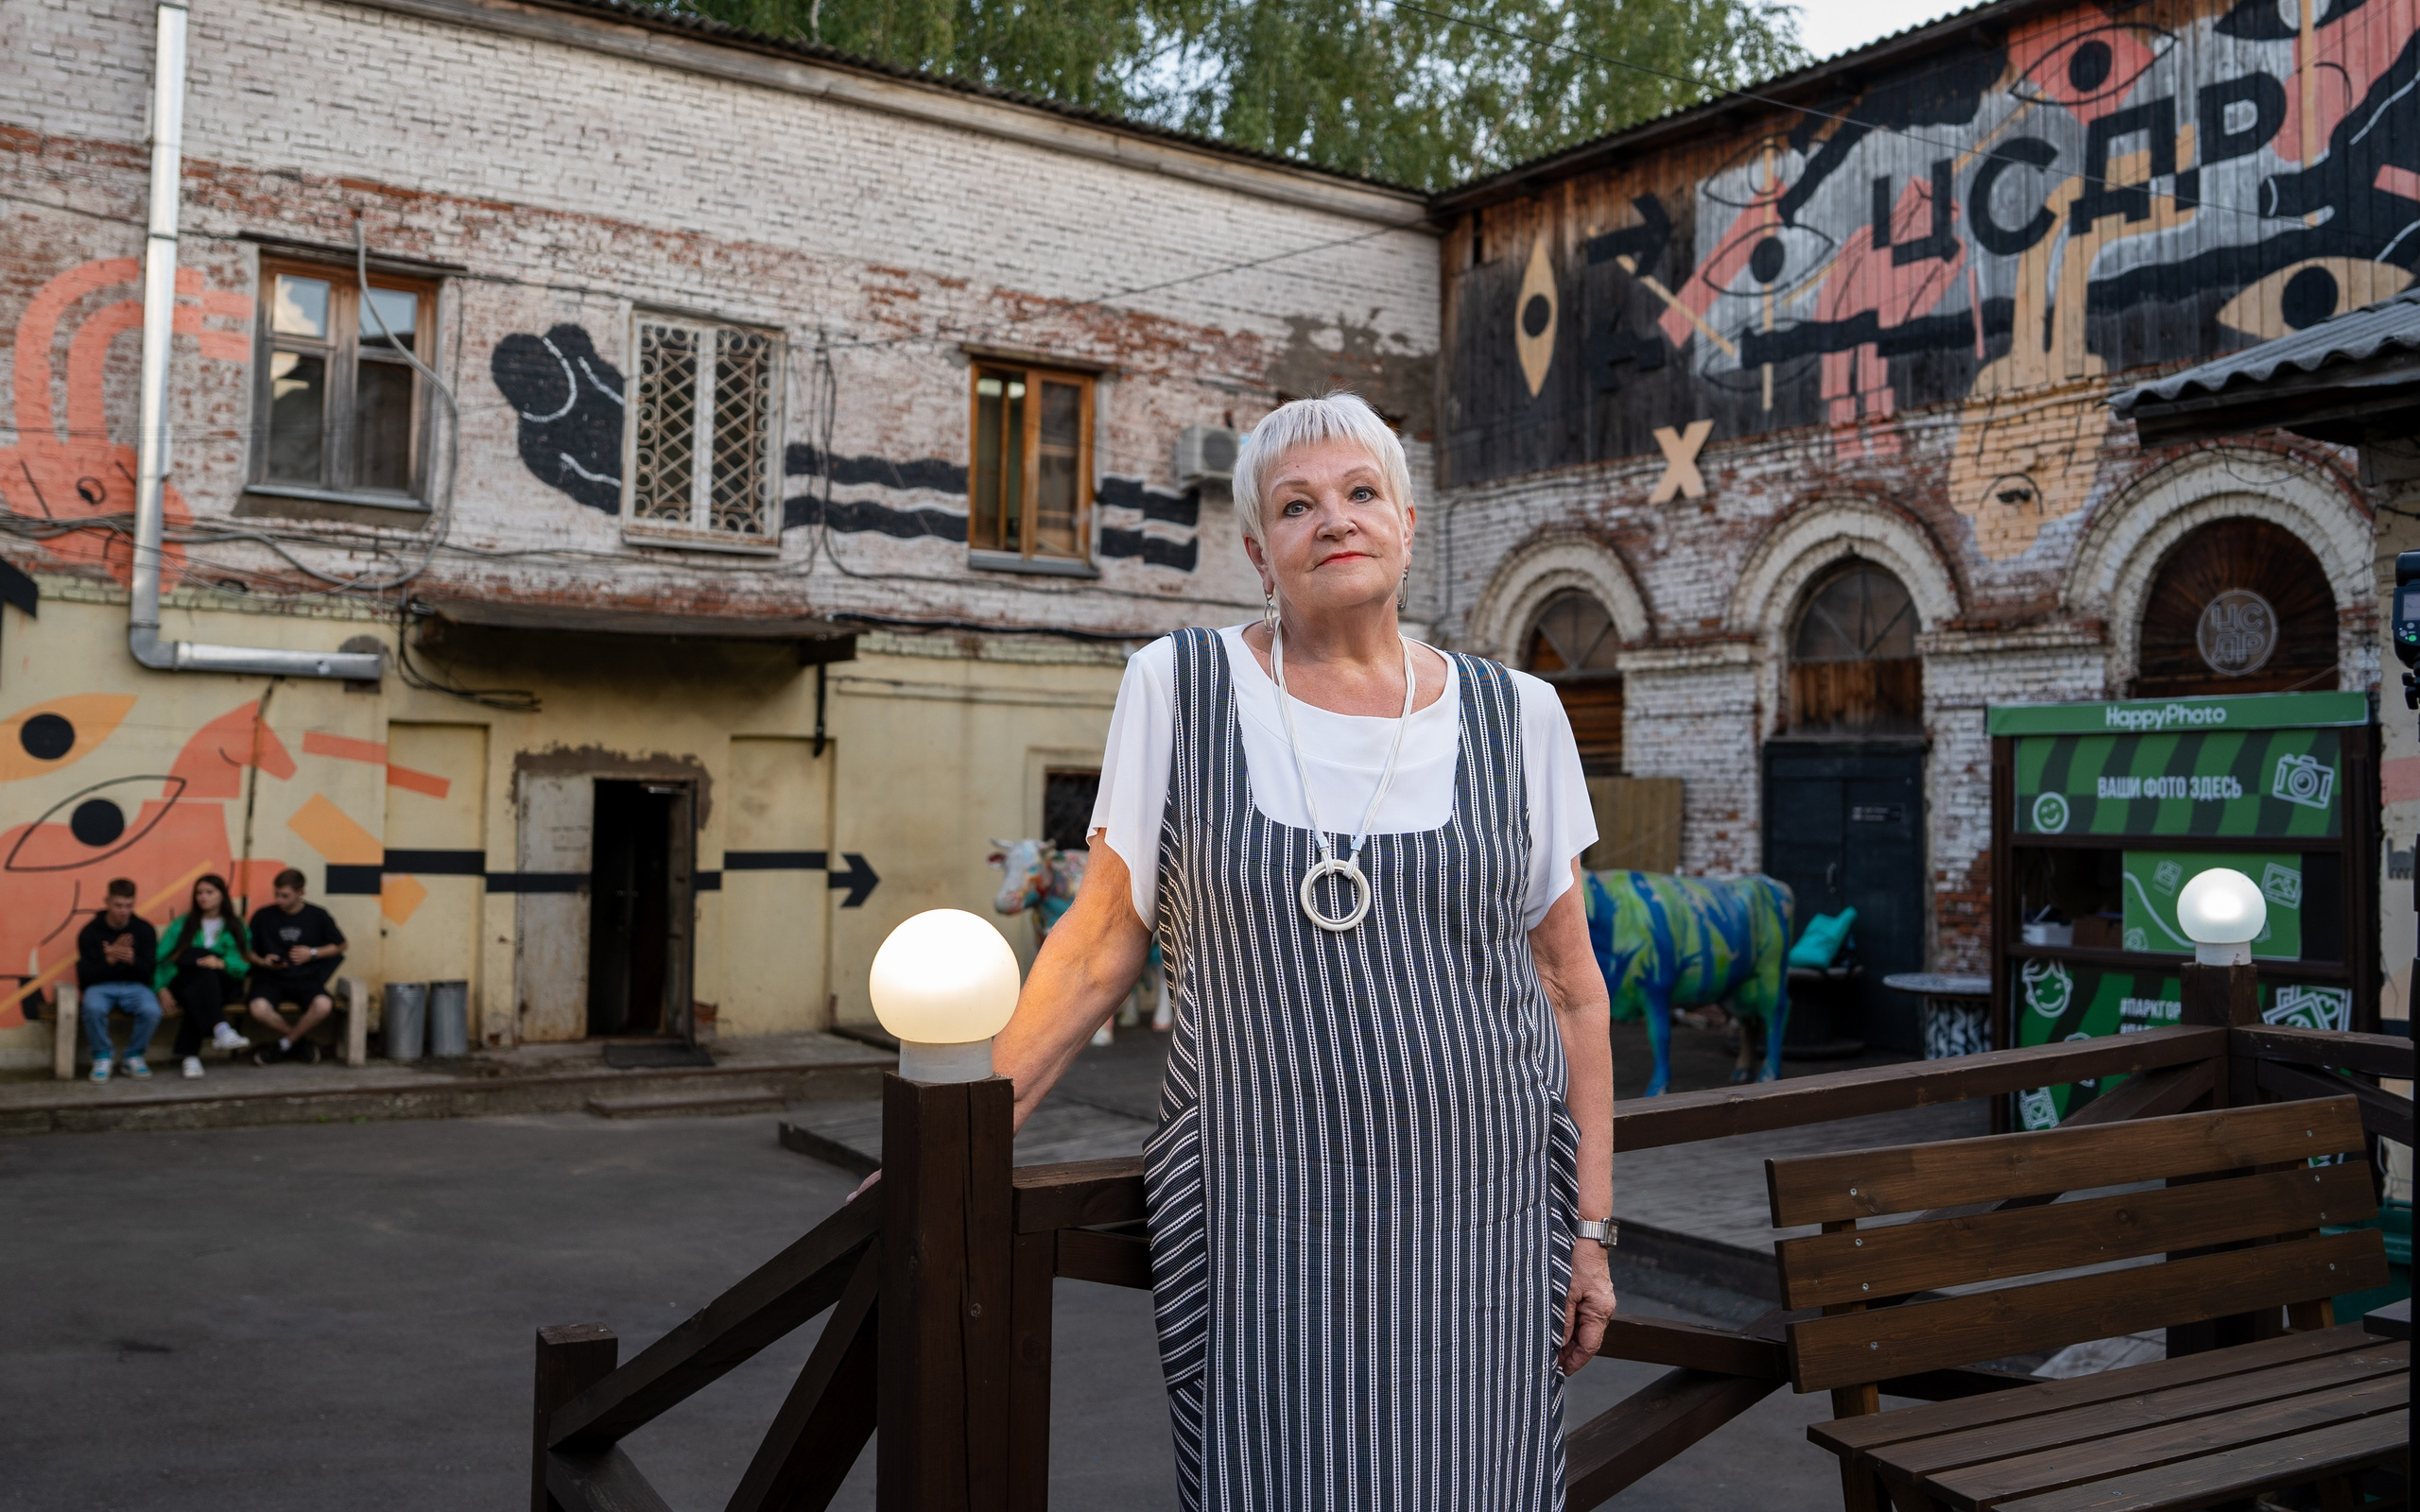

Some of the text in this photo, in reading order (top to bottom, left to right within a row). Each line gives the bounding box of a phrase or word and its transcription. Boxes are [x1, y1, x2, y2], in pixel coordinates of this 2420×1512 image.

[2105, 703, 2227, 730] HappyPhoto
[2097, 776, 2242, 801] ВАШИ ФОТО ЗДЕСЬ
